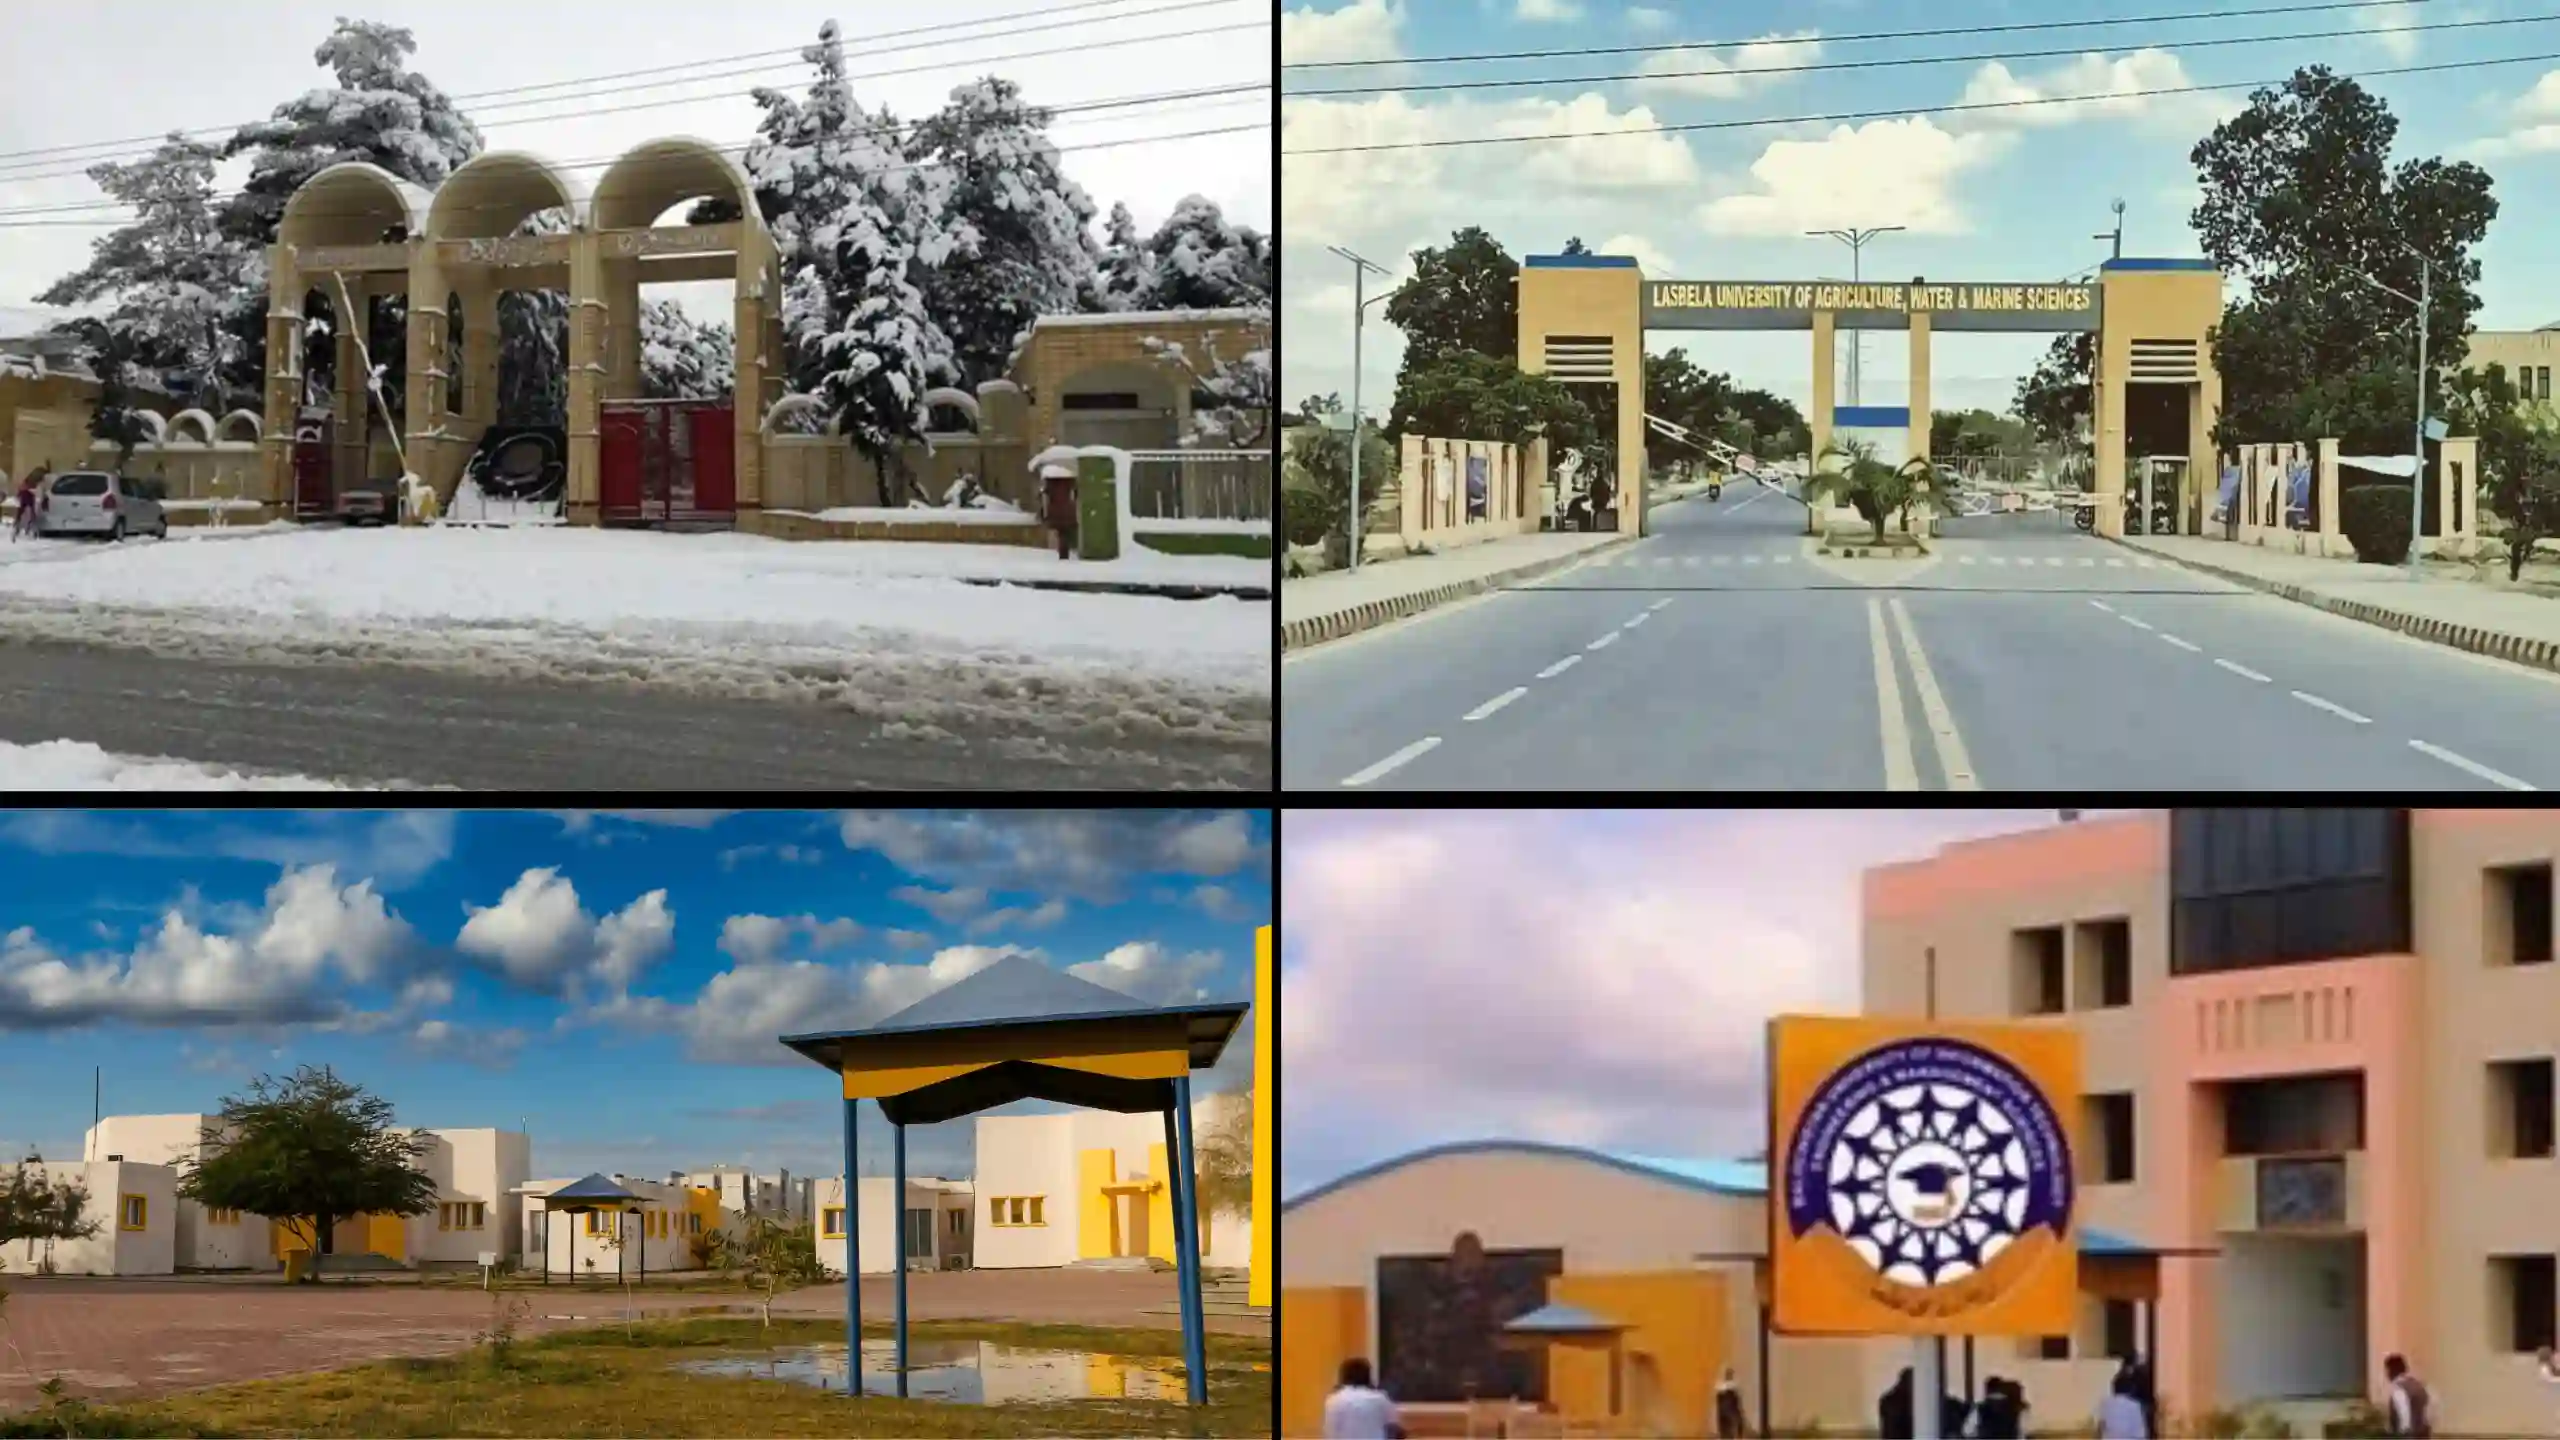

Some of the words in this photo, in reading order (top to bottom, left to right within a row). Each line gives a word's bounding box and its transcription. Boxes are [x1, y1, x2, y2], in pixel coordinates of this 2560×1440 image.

[1653, 285, 1713, 307] LASBELA
[1717, 285, 1792, 308] UNIVERSITY
[1795, 286, 1813, 308] OF
[1815, 286, 1907, 313] AGRICULTURE,
[1910, 286, 1953, 309] WATER
[1957, 287, 1968, 308] &
[1973, 287, 2022, 309] MARINE
[2027, 287, 2090, 310] SCIENCES
